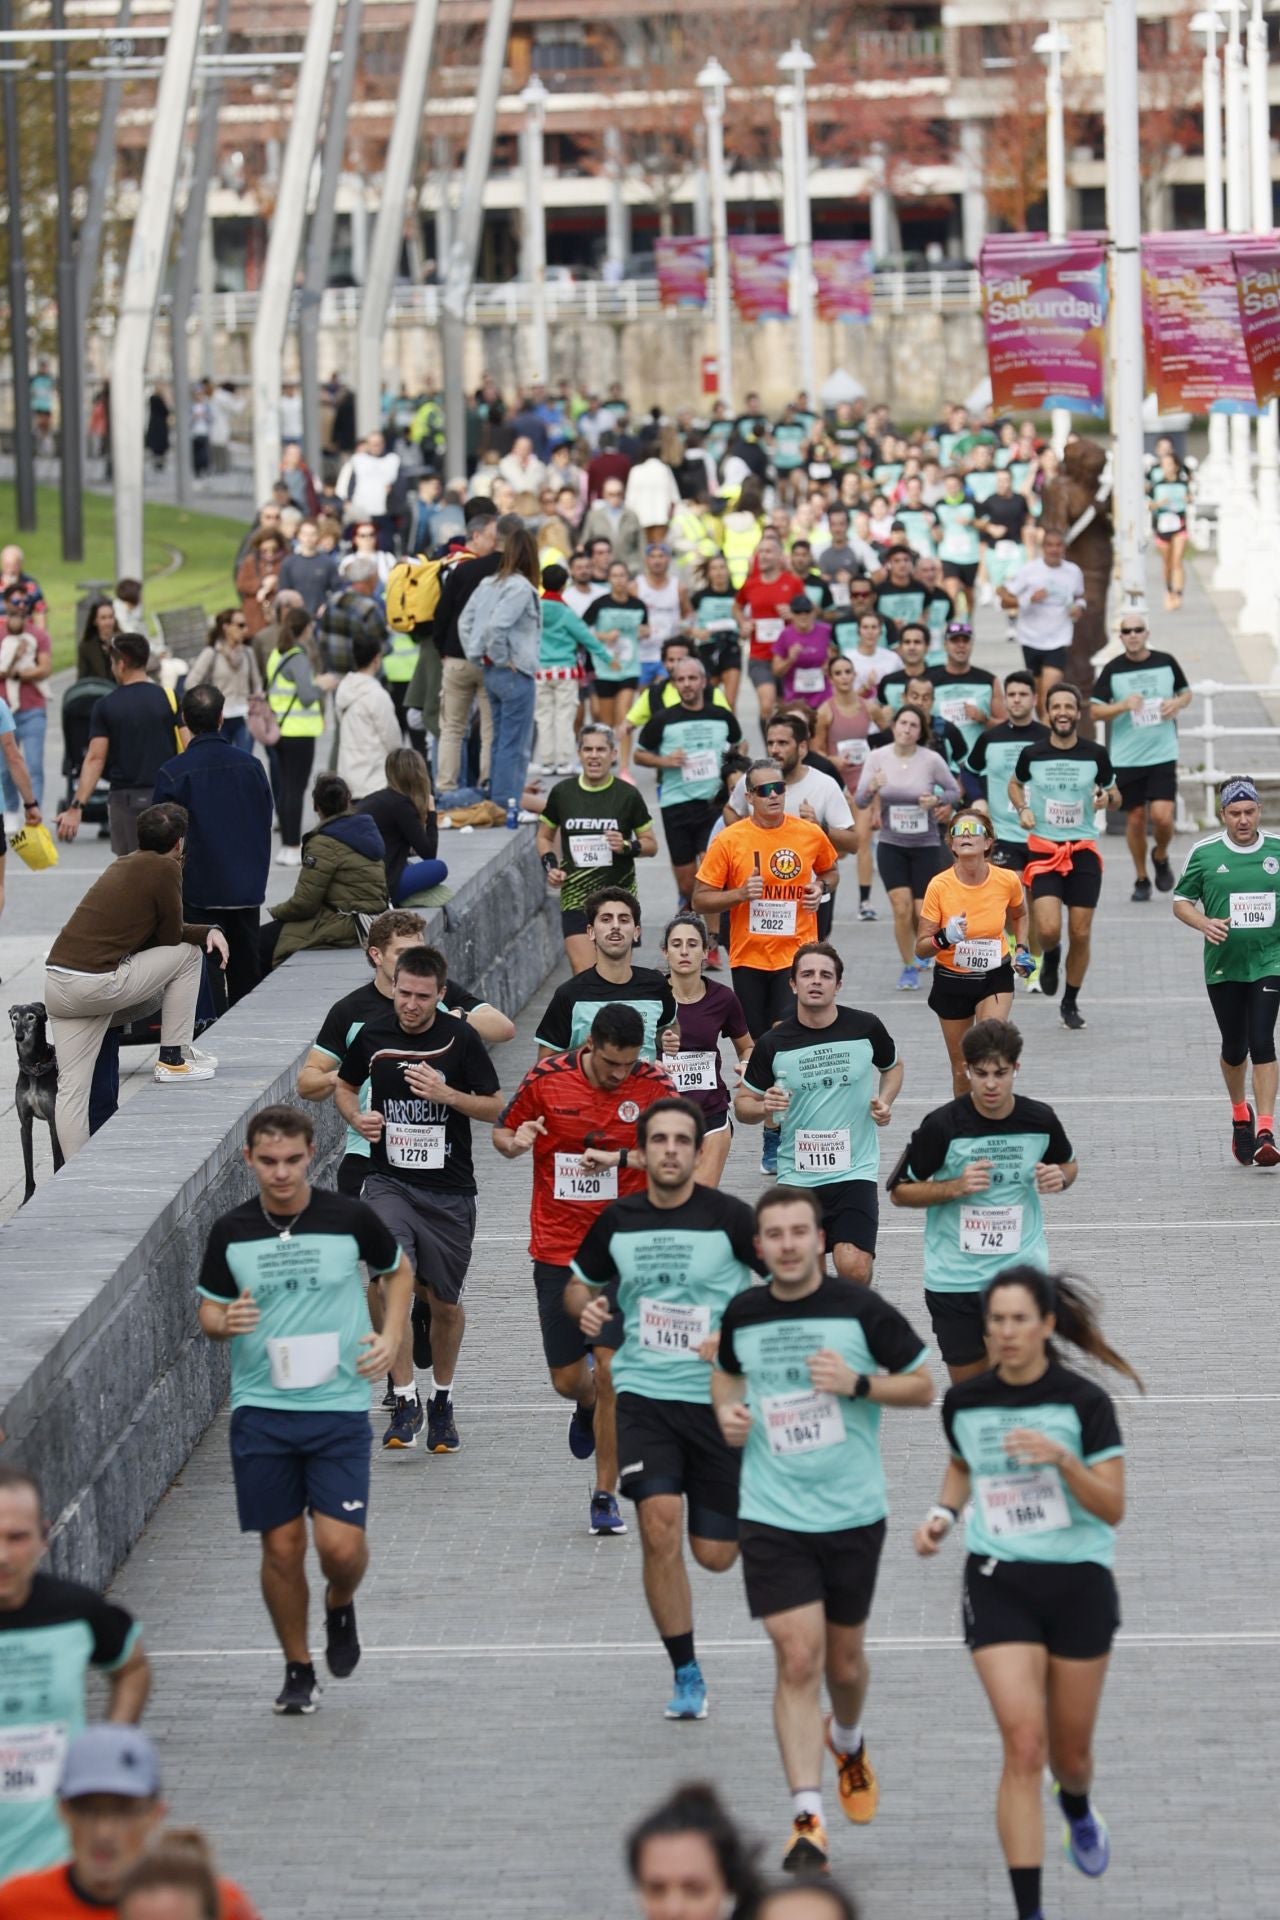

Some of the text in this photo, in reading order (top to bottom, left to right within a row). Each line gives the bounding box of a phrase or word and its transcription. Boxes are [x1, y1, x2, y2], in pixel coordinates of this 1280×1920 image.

[986, 275, 1032, 301] Fair
[1242, 270, 1280, 294] Fai
[988, 297, 1102, 327] Saturday
[565, 818, 619, 830] OTENTA
[583, 852, 598, 862] 264
[1243, 911, 1265, 923] 1094
[761, 919, 784, 930] 2022
[966, 956, 989, 968] 1903
[814, 1048, 833, 1056] XXXVI
[678, 1072, 703, 1086] 1299
[404, 1127, 431, 1135] CORREO
[389, 1135, 412, 1147] XXXVI
[798, 1142, 820, 1152] XXXVI
[400, 1148, 428, 1162] 1278
[809, 1153, 836, 1166] 1116
[571, 1179, 600, 1194] 1420
[965, 1219, 990, 1230] XXXVI
[980, 1233, 1003, 1247] 742
[657, 1330, 689, 1348] 1419
[785, 1423, 821, 1445] 1047
[1006, 1505, 1046, 1526] 1664
